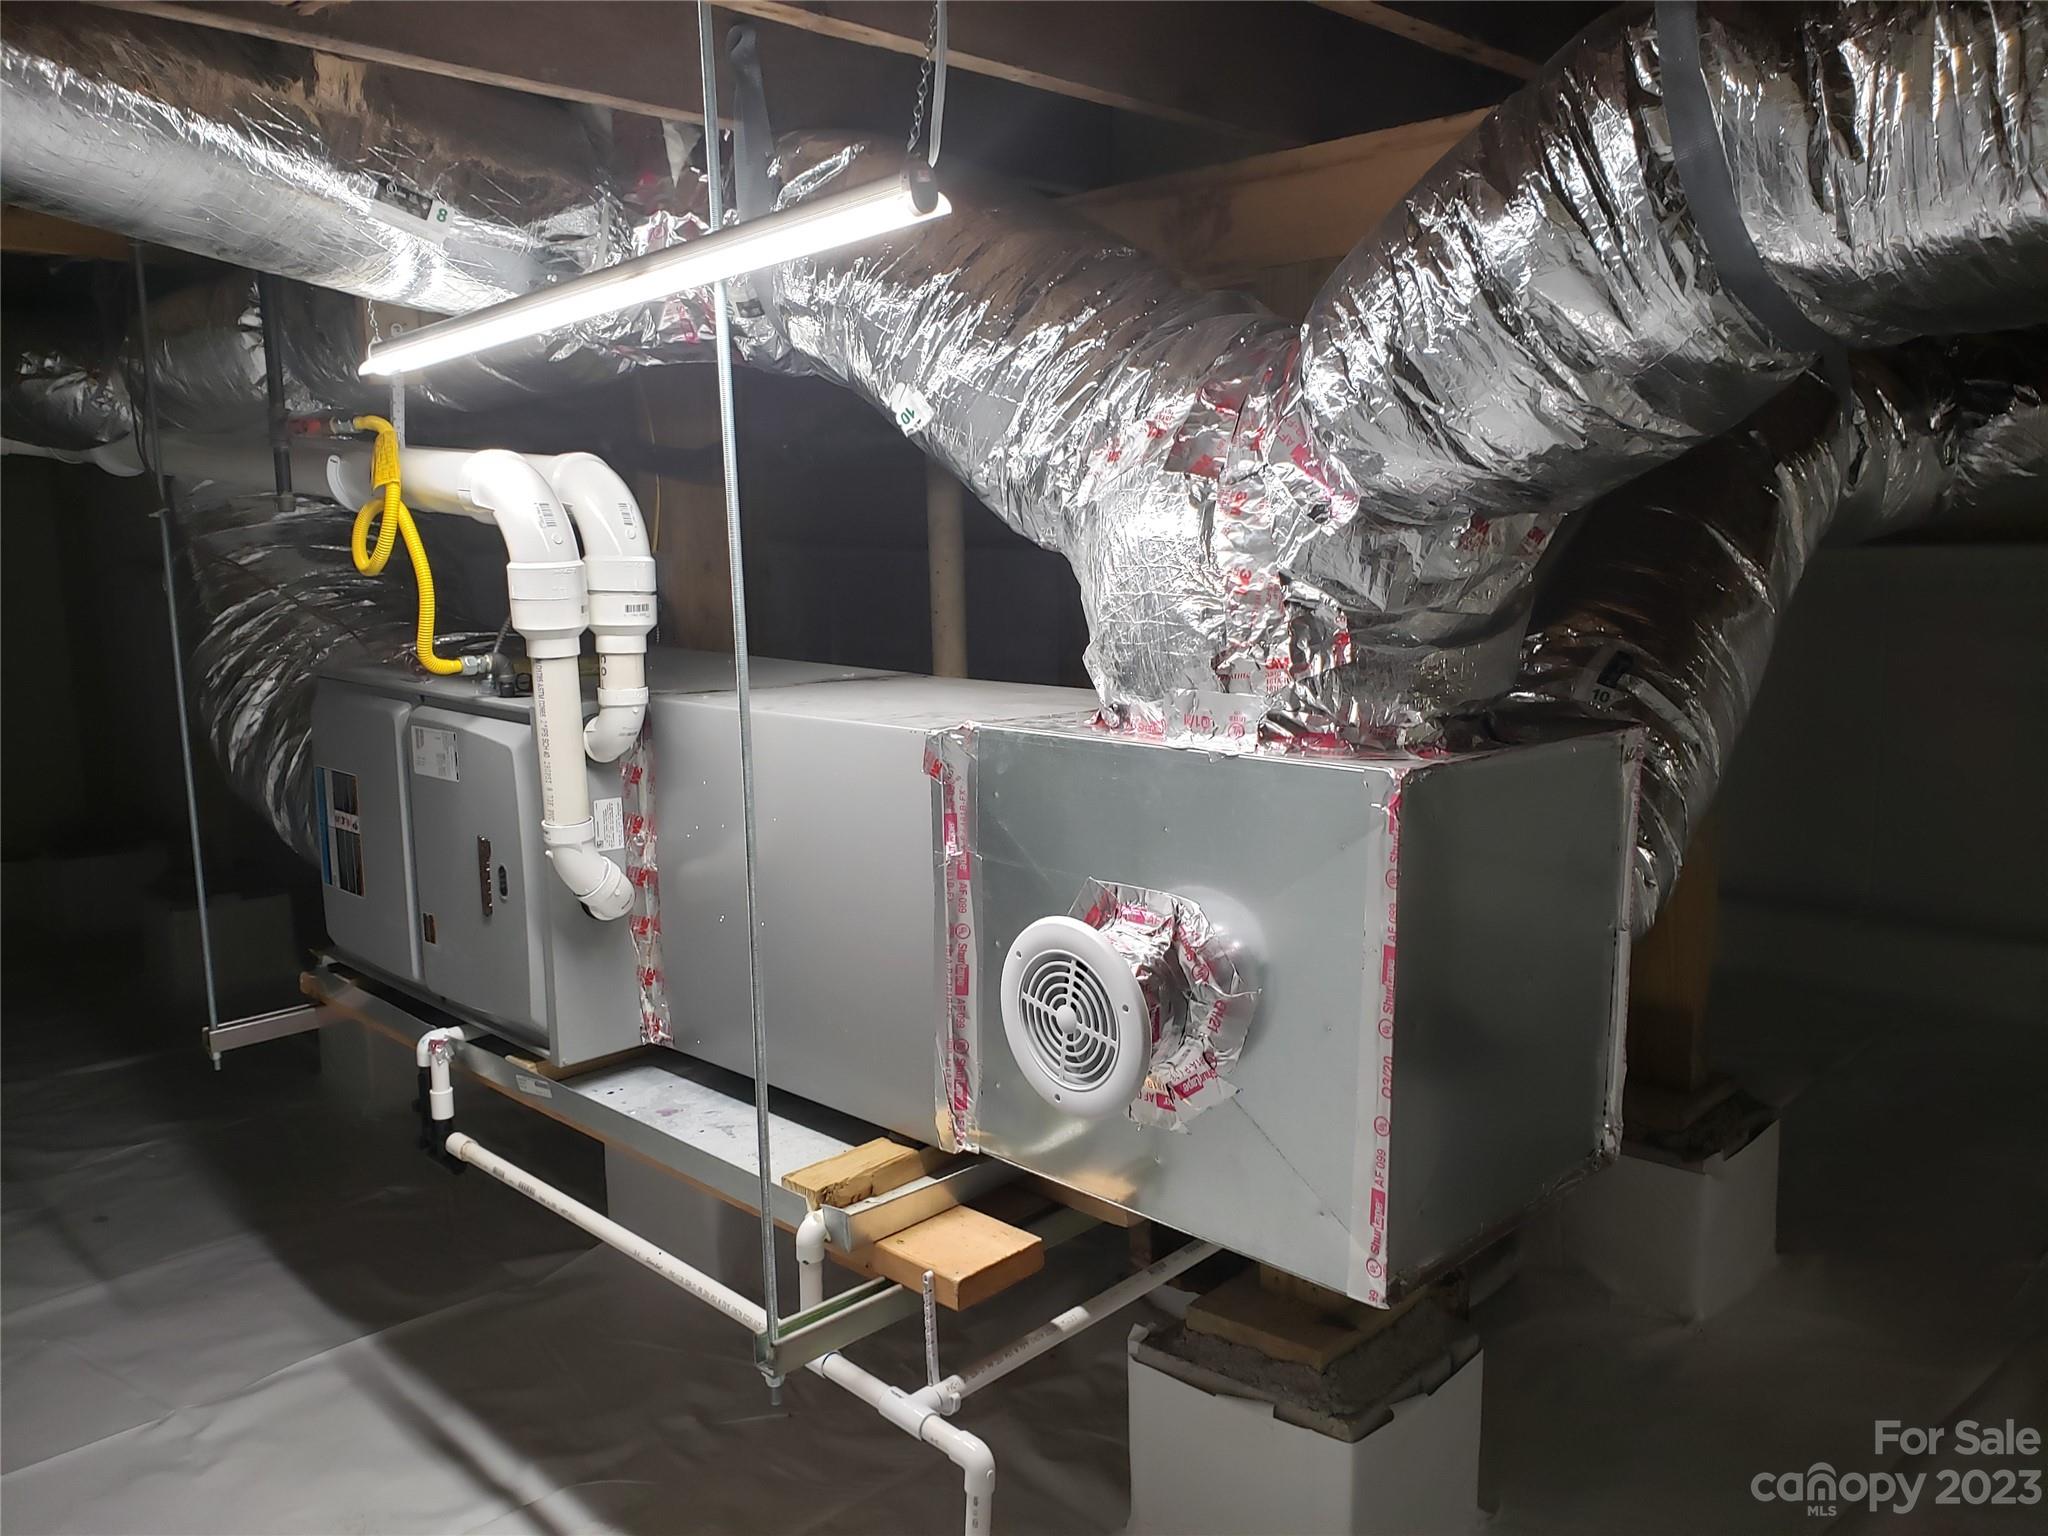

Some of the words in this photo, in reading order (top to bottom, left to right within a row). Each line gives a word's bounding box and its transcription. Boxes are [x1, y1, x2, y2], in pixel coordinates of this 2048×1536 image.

[436, 207, 448, 222] 8
[900, 407, 915, 425] 10
[1592, 688, 1610, 703] 10
[959, 897, 968, 914] 099
[1375, 1149, 1387, 1169] 099
[1374, 1169, 1385, 1189] AF
[1370, 1203, 1384, 1256] Shurtape
